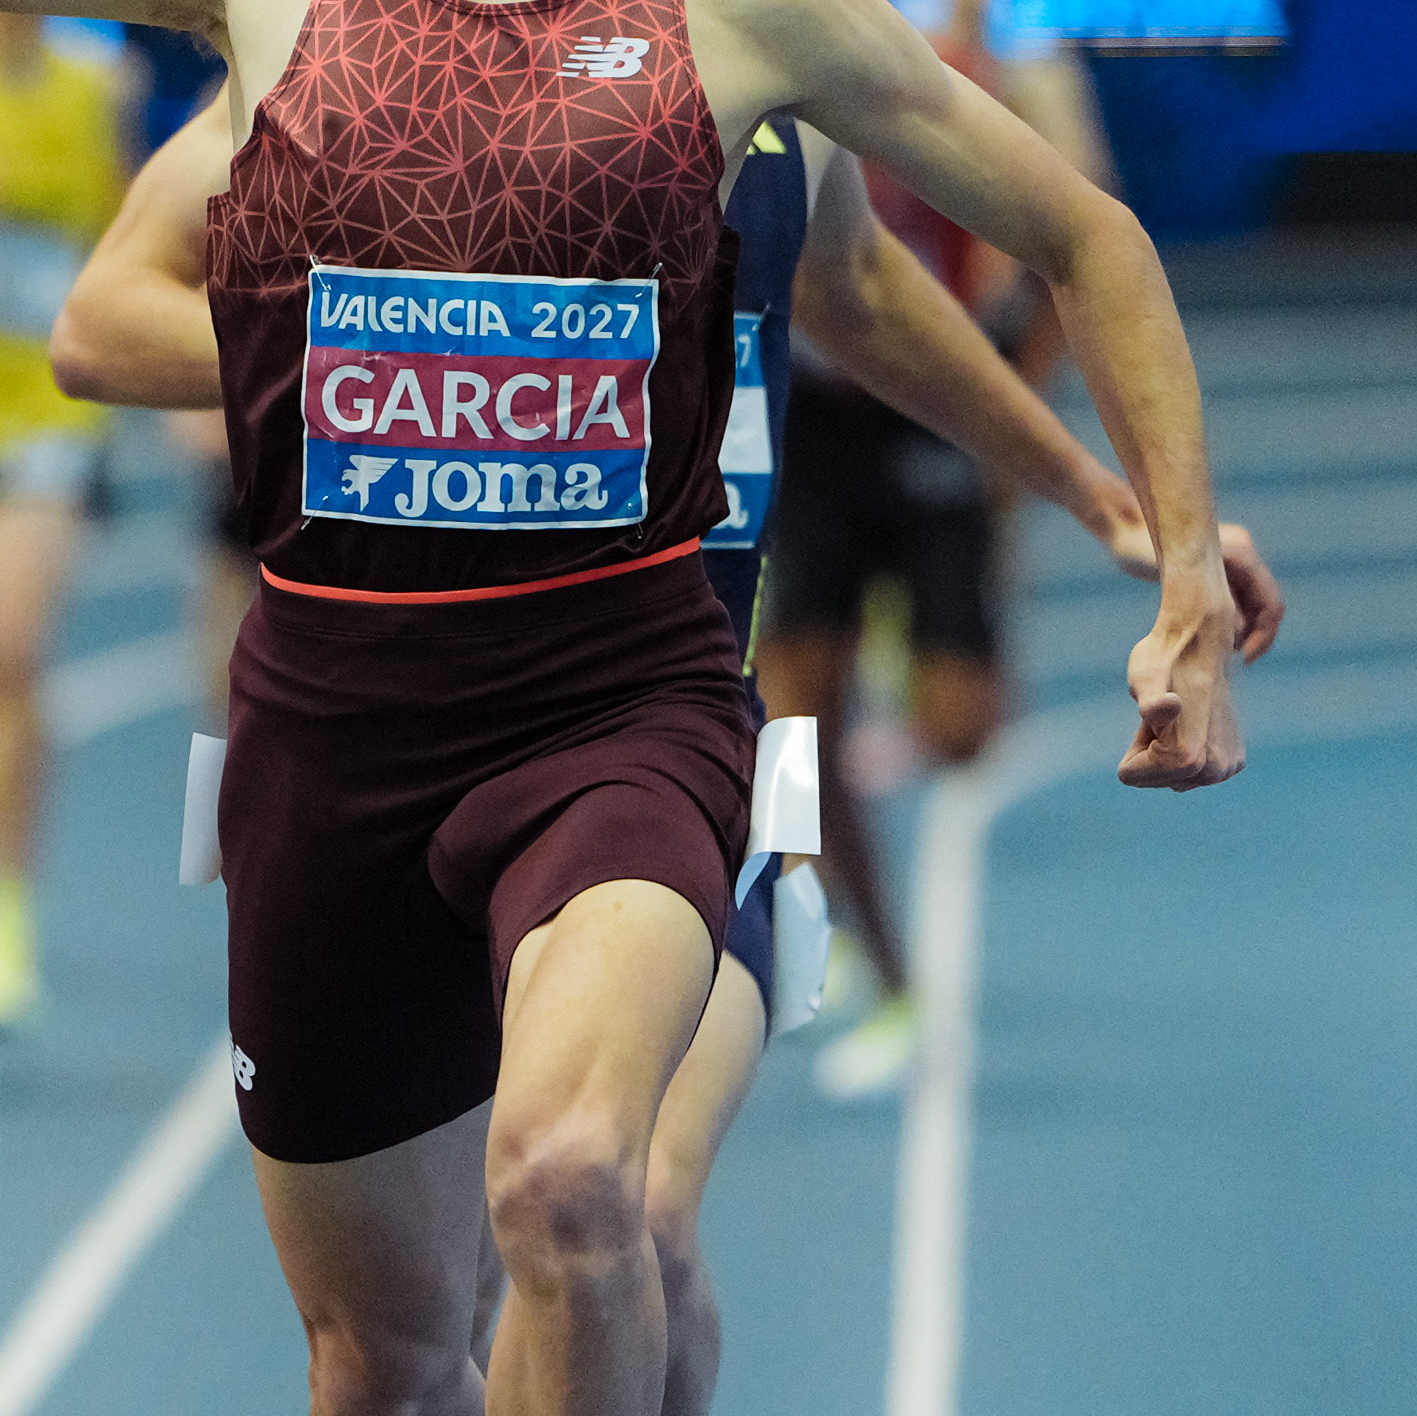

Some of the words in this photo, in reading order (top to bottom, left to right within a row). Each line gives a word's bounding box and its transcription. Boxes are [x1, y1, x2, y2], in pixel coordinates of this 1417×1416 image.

[320, 291, 510, 338] VALENCIA
[531, 302, 640, 340] 2027
[320, 364, 631, 442] GARCIA
